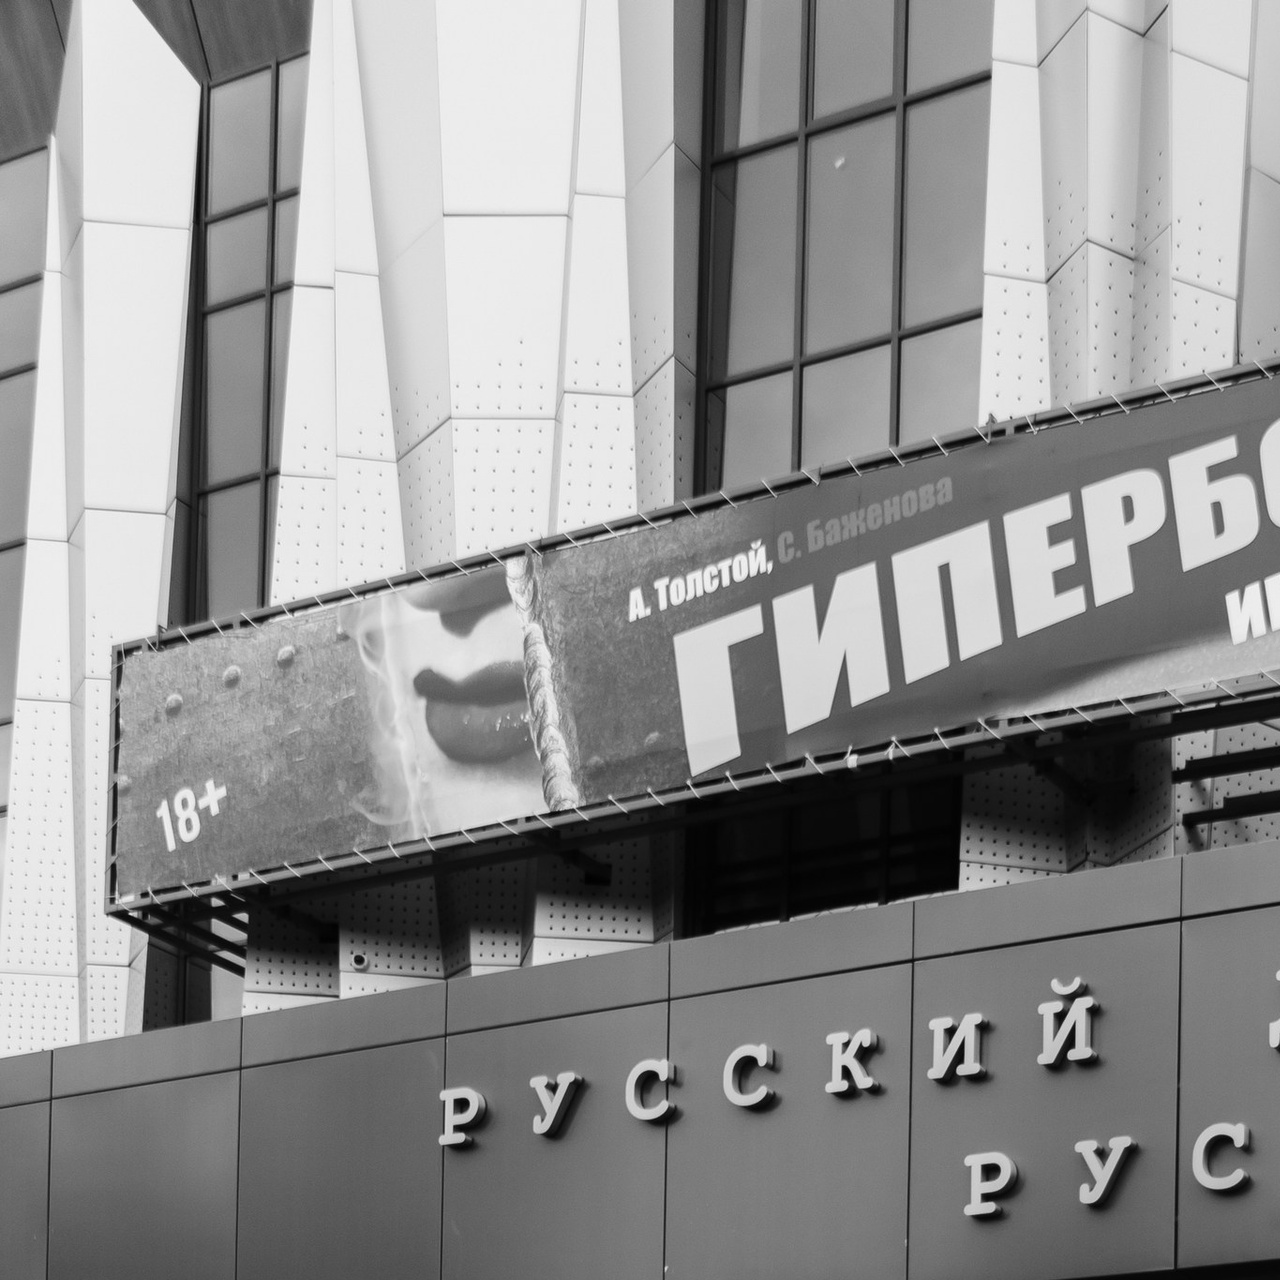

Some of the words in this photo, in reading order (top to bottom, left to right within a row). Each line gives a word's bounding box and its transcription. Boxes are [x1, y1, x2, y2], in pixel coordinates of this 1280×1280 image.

[628, 585, 651, 623] А.
[653, 539, 774, 612] Толстой,
[776, 530, 802, 564] С.
[806, 476, 954, 554] Баженова
[155, 778, 228, 853] 18+
[438, 976, 1102, 1148] РУССКИЙ
[964, 1122, 1251, 1217] РУС
